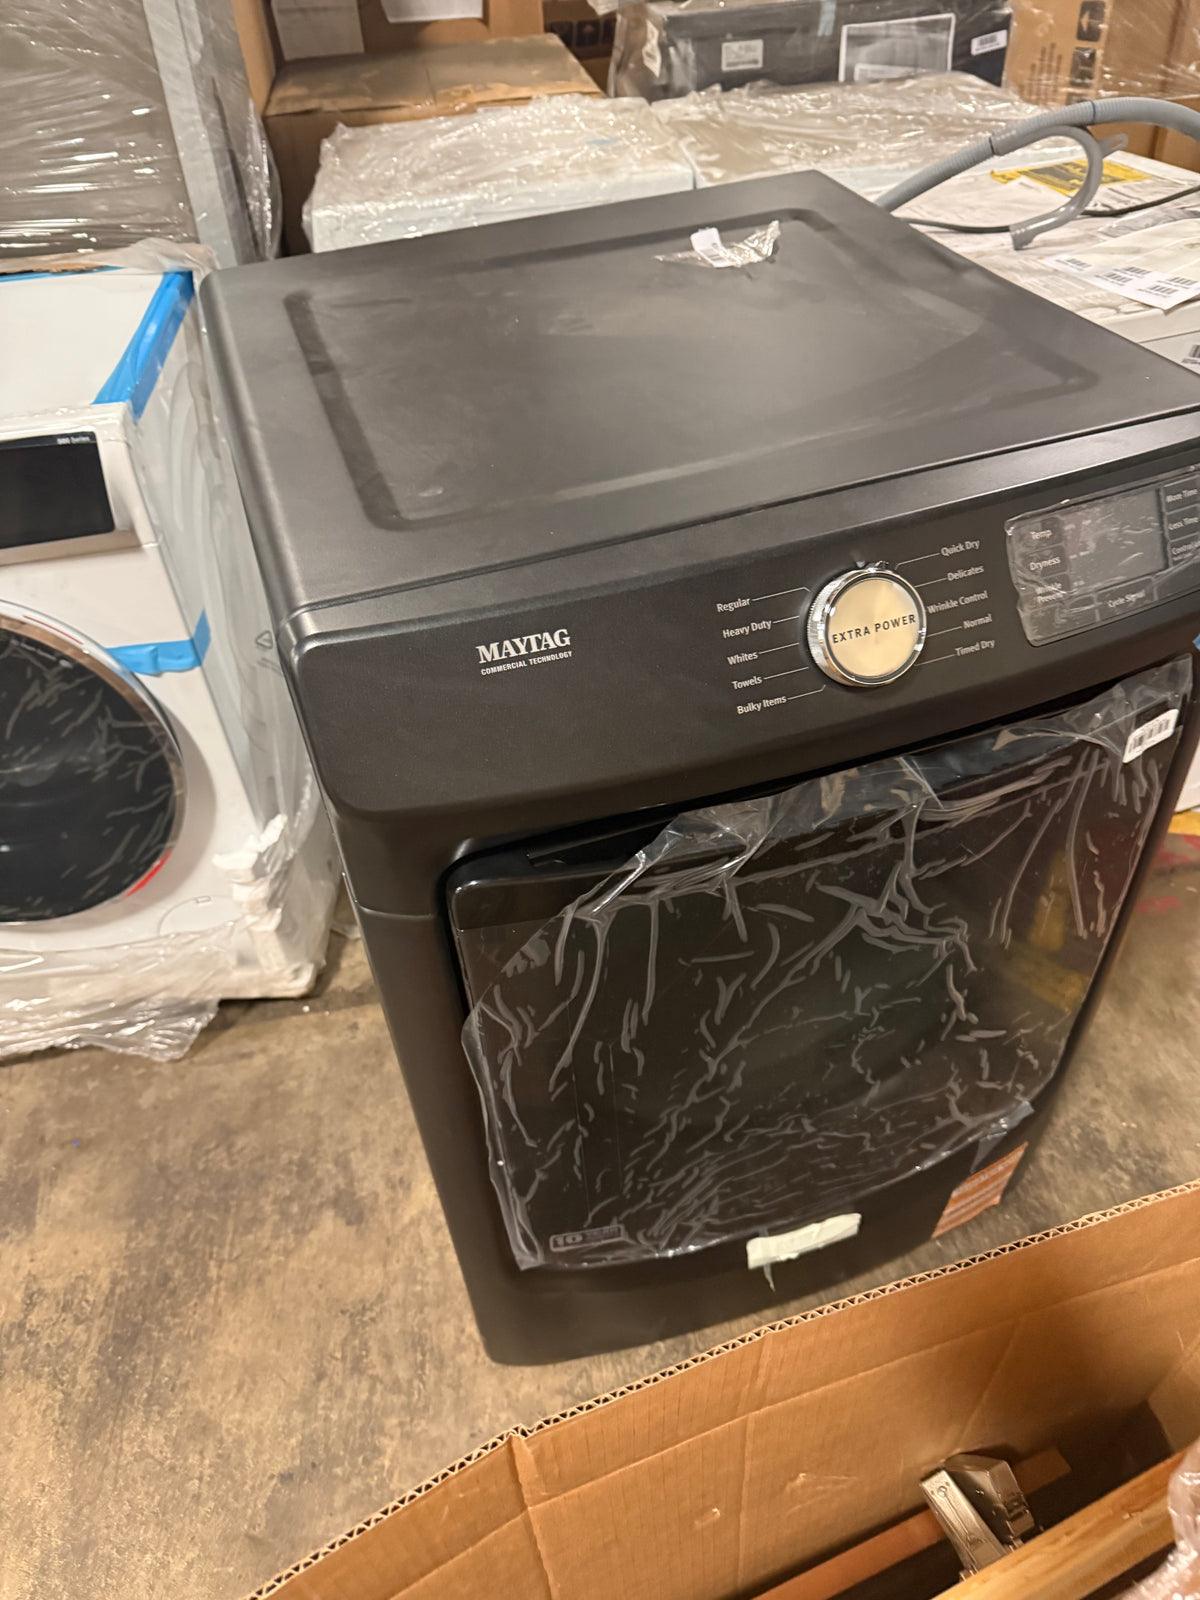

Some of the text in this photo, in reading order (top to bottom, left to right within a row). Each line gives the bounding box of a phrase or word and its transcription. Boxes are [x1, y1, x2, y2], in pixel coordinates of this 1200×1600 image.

[1030, 528, 1052, 541] Temp
[940, 539, 980, 556] Quick Dry
[1029, 556, 1061, 571] Dryness
[947, 566, 984, 581] Delicates
[716, 598, 750, 612] Regular
[926, 590, 989, 614] Wrinkle Control
[722, 620, 772, 639] Heavy Duty
[832, 614, 916, 644] EXTRA POWER
[963, 614, 992, 629] Normal
[475, 628, 571, 664] MAYTAG
[955, 639, 996, 657] Timed Dry
[480, 650, 573, 676] COMMERCIAL TECHNOLOGY
[727, 652, 758, 665] Whites
[732, 676, 762, 689] Towels
[736, 695, 788, 715] Bulky Items
